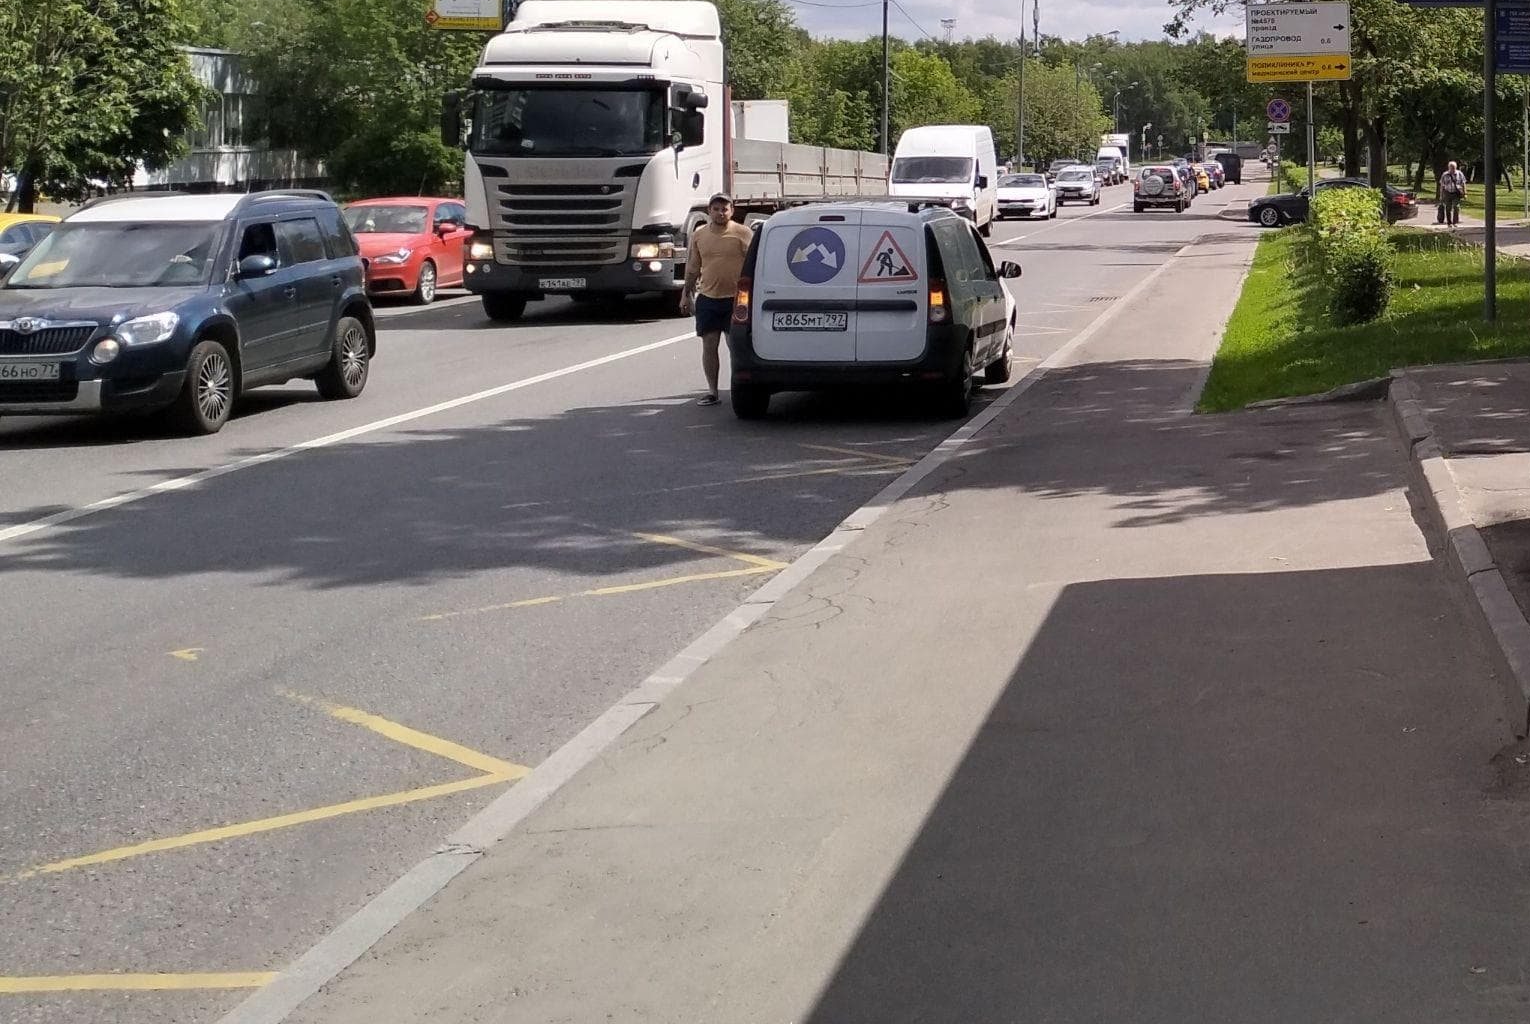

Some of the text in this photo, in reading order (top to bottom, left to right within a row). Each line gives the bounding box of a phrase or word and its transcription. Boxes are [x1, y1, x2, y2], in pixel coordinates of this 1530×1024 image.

[1250, 8, 1318, 17] ПРОЕКТИРУЕМЫЙ
[1251, 35, 1302, 43] ГАЗОПРОВОД
[777, 314, 843, 327] К865МТ 797
[0, 363, 55, 378] 66НО 77
